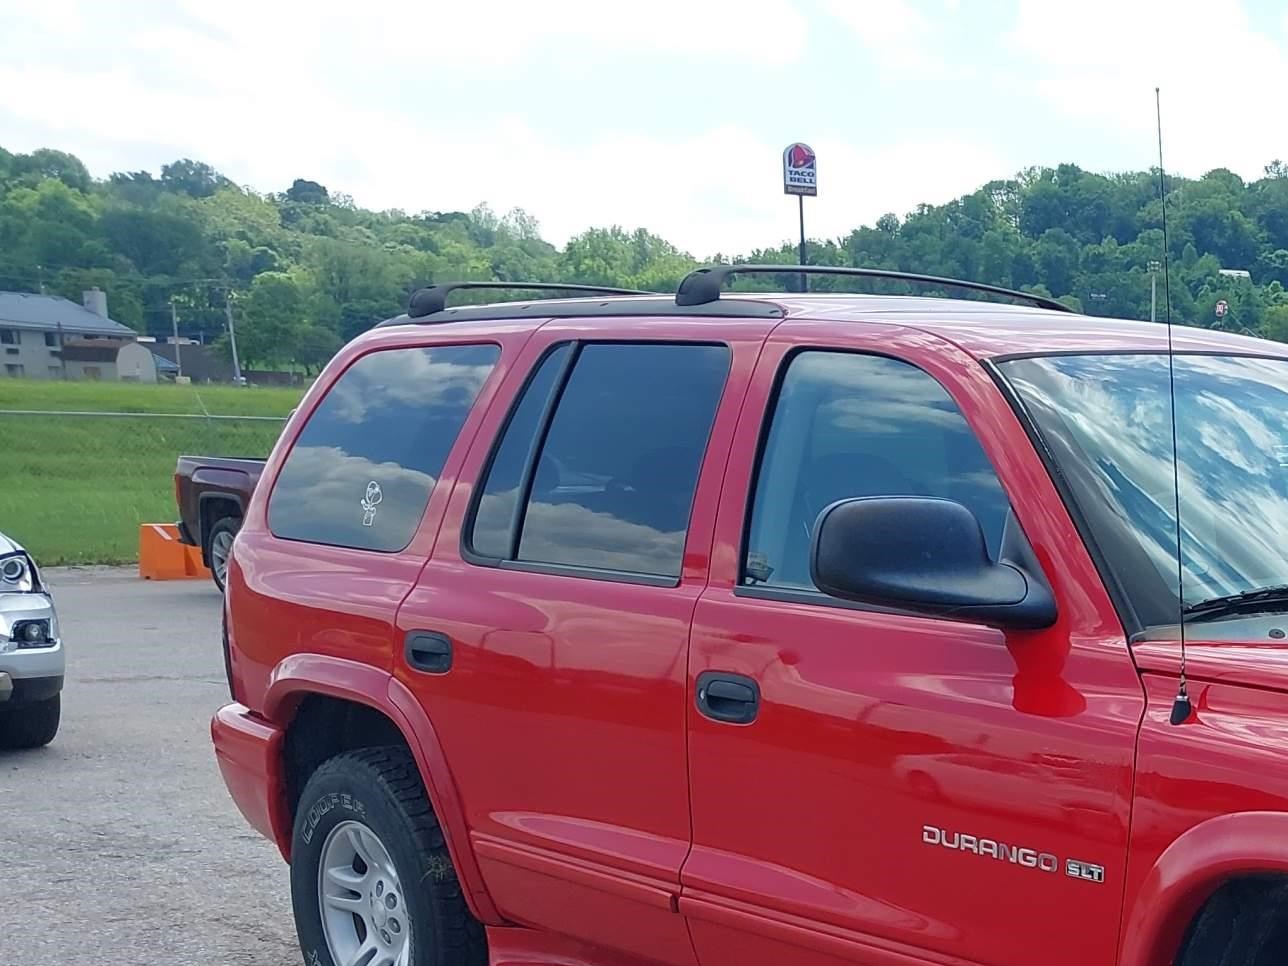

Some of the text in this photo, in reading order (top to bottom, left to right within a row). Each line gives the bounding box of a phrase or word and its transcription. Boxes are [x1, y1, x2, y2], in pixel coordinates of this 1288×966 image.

[302, 792, 367, 845] COOPER
[922, 825, 1104, 882] DURANGO SLT
